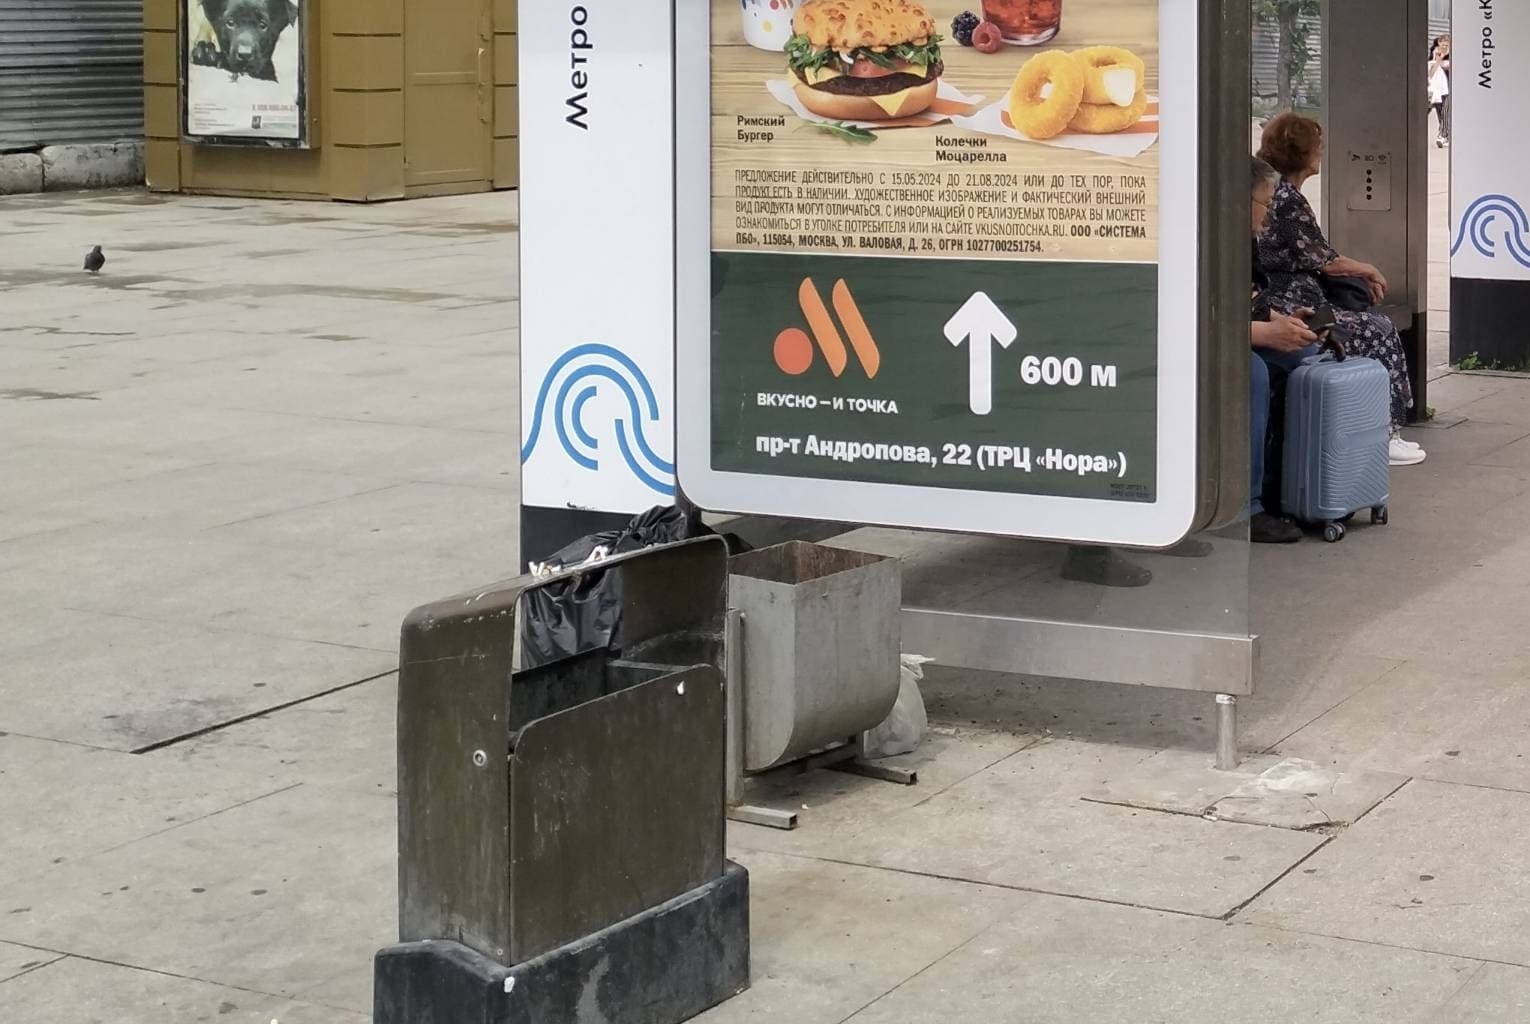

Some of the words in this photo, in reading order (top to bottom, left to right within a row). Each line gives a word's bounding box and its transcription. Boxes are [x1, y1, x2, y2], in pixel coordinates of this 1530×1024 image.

[564, 7, 593, 130] Метро
[1478, 27, 1496, 89] Метро
[737, 115, 785, 128] Римский
[737, 129, 774, 143] Бургер
[935, 135, 988, 149] Колечки
[935, 150, 1007, 164] Моцарелла
[736, 170, 797, 184] ПРЕДЛОЖЕНИЕ
[802, 169, 874, 185] ДЕЙСТВИТЕЛЬНО
[880, 173, 886, 184] С
[947, 174, 960, 187] ДО
[966, 174, 1018, 187] 21.08.2024
[1024, 175, 1044, 187] ИЛИ
[1051, 175, 1064, 188] ДО
[1070, 175, 1086, 188] ТЕХ
[1092, 175, 1114, 190] ПОР,
[1120, 176, 1146, 188] ПОКА
[736, 186, 770, 199] ПРОДУКТ
[773, 187, 792, 198] ЕСТЬ
[797, 187, 803, 198] В
[854, 189, 934, 202] ХУДОЖЕСТВЕННОЕ
[939, 190, 1007, 203] ИЗОБРАЖЕНИЕ
[1011, 191, 1018, 203] И
[1022, 189, 1092, 204] ФАКТИЧЕСКИЙ
[1096, 190, 1146, 205] ВНЕШНИЙ
[736, 201, 752, 215] ВИД
[754, 202, 795, 216] ПРОДУКТА
[797, 203, 824, 215] МОГУТ
[826, 204, 882, 217] ОТЛИЧАТЬСЯ.
[886, 205, 892, 217] С
[894, 205, 965, 220] ИНФОРМАЦИЕЙ
[968, 207, 974, 219] О
[977, 207, 1045, 220] РЕАЛИЗУЕМЫХ
[1048, 208, 1087, 220] ТОВАРАХ
[1090, 209, 1103, 221] ВЫ
[1106, 209, 1146, 222] МОЖЕТЕ
[736, 216, 801, 230] ОЗНАКОМИТЬСЯ
[804, 219, 810, 230] В
[812, 219, 842, 231] УГОЛКЕ
[845, 220, 906, 233] ПОТРЕБИТЕЛЯ
[909, 221, 929, 233] ИЛИ
[931, 222, 943, 233] НА
[946, 221, 973, 235] САЙТЕ
[1071, 225, 1091, 237] ООО
[1095, 225, 1146, 238] «СИСТЕМА
[763, 234, 795, 248] 115054,
[799, 235, 839, 249] МОСКВА,
[842, 236, 856, 248] УЛ.
[860, 237, 905, 251] ВАЛОВАЯ,
[908, 238, 918, 252] Д.
[921, 238, 936, 252] 26,
[939, 239, 963, 251] ОГРН
[1020, 356, 1083, 387] 600
[1091, 364, 1117, 387] м
[757, 393, 817, 409] ВКУСНО
[832, 397, 844, 410] И
[847, 397, 898, 414] ТОЧКА
[756, 435, 801, 457] пр-т
[805, 435, 938, 468] Андропова,
[942, 443, 972, 466] 22
[976, 446, 1031, 472] (ТРЦ
[1035, 450, 1127, 477] «Нора»)
